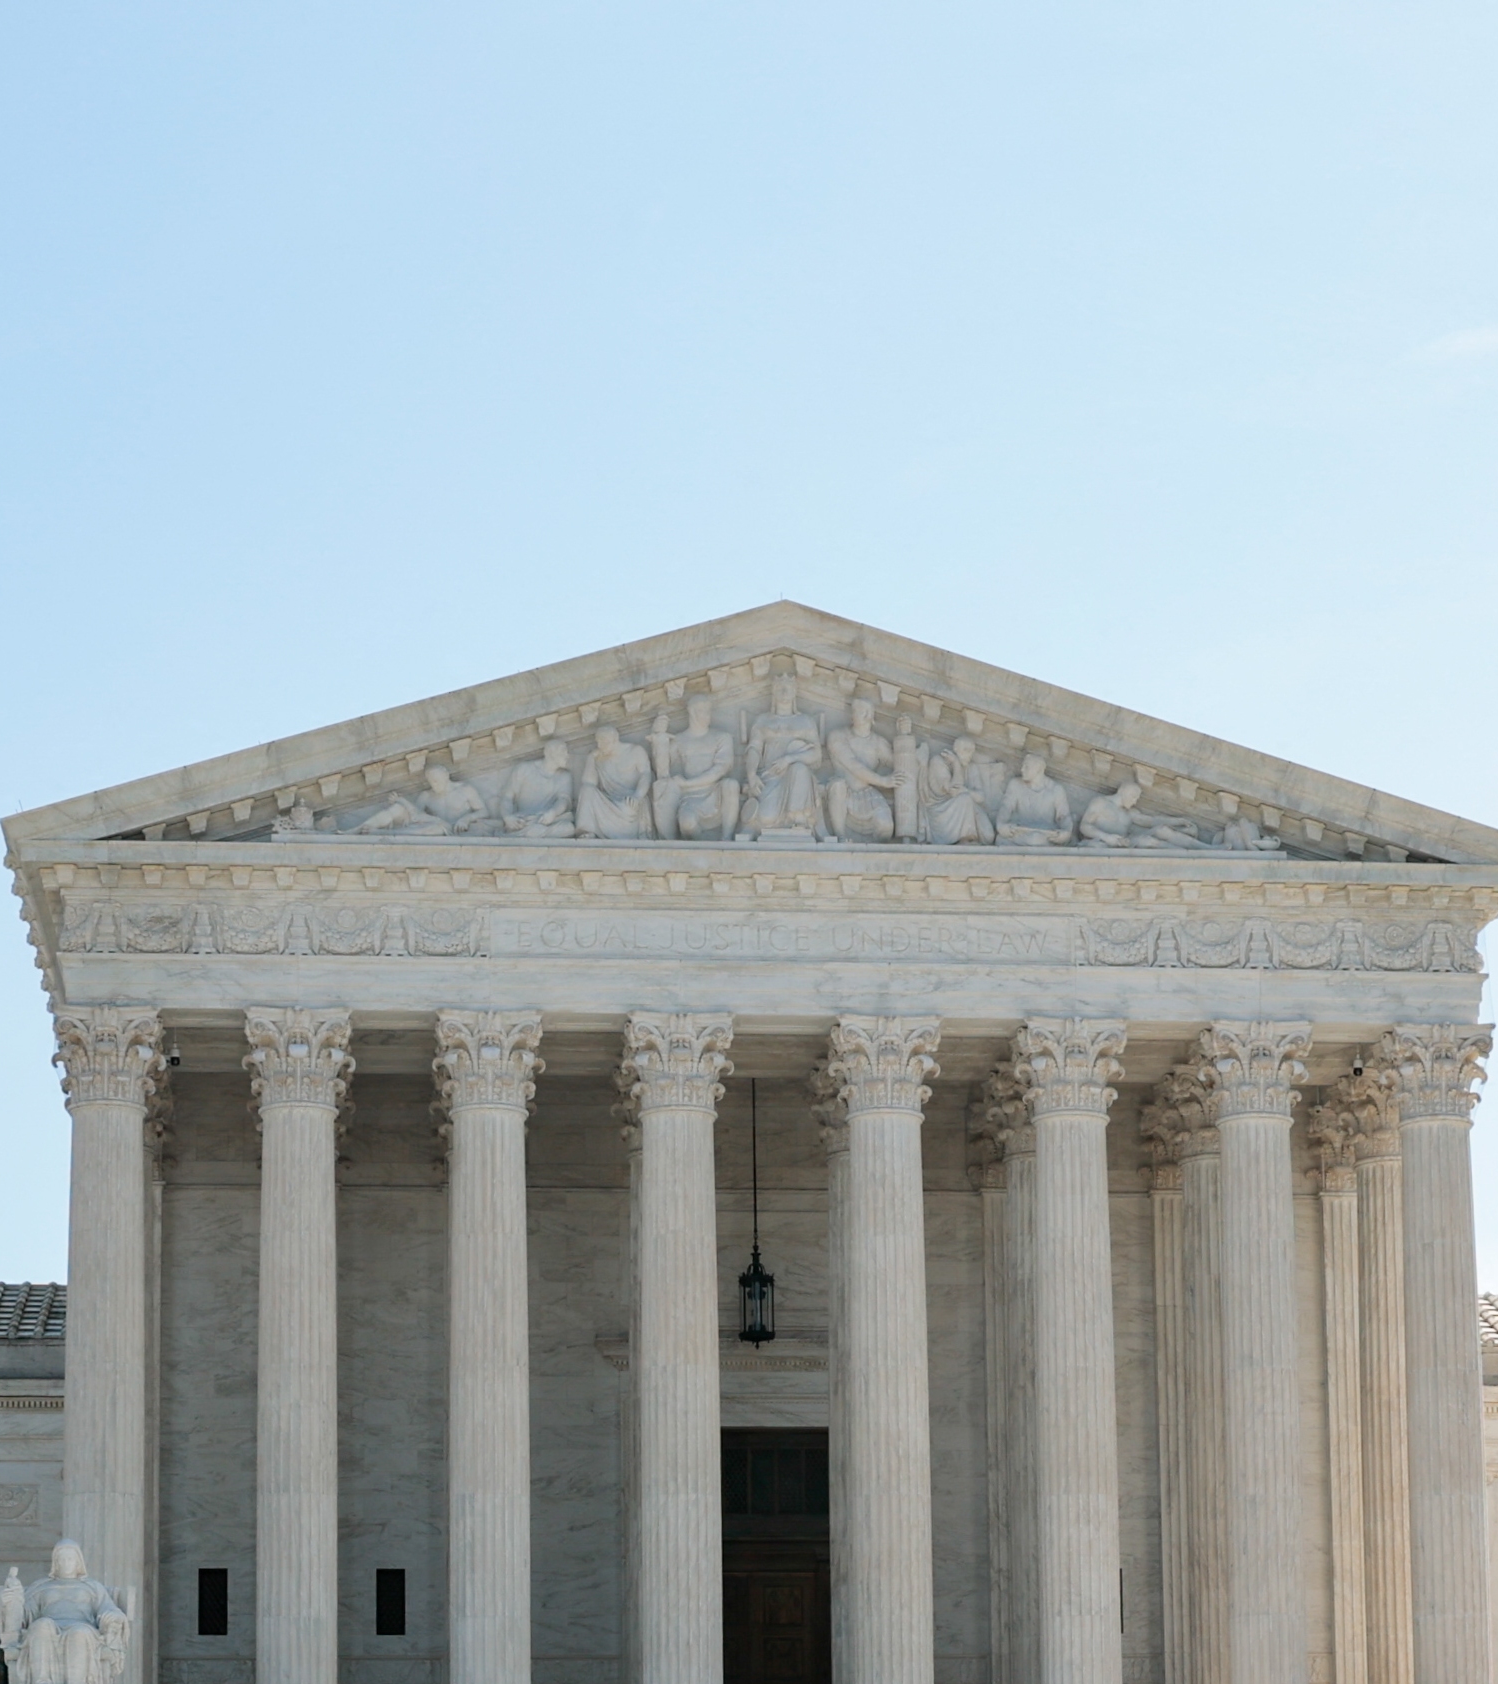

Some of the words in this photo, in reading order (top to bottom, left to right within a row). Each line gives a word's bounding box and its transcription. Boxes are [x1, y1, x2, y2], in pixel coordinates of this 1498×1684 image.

[517, 921, 648, 950] EQUAL
[660, 924, 810, 951] JUSTICE
[831, 926, 956, 953] UNDER
[977, 929, 1047, 955] LAW
